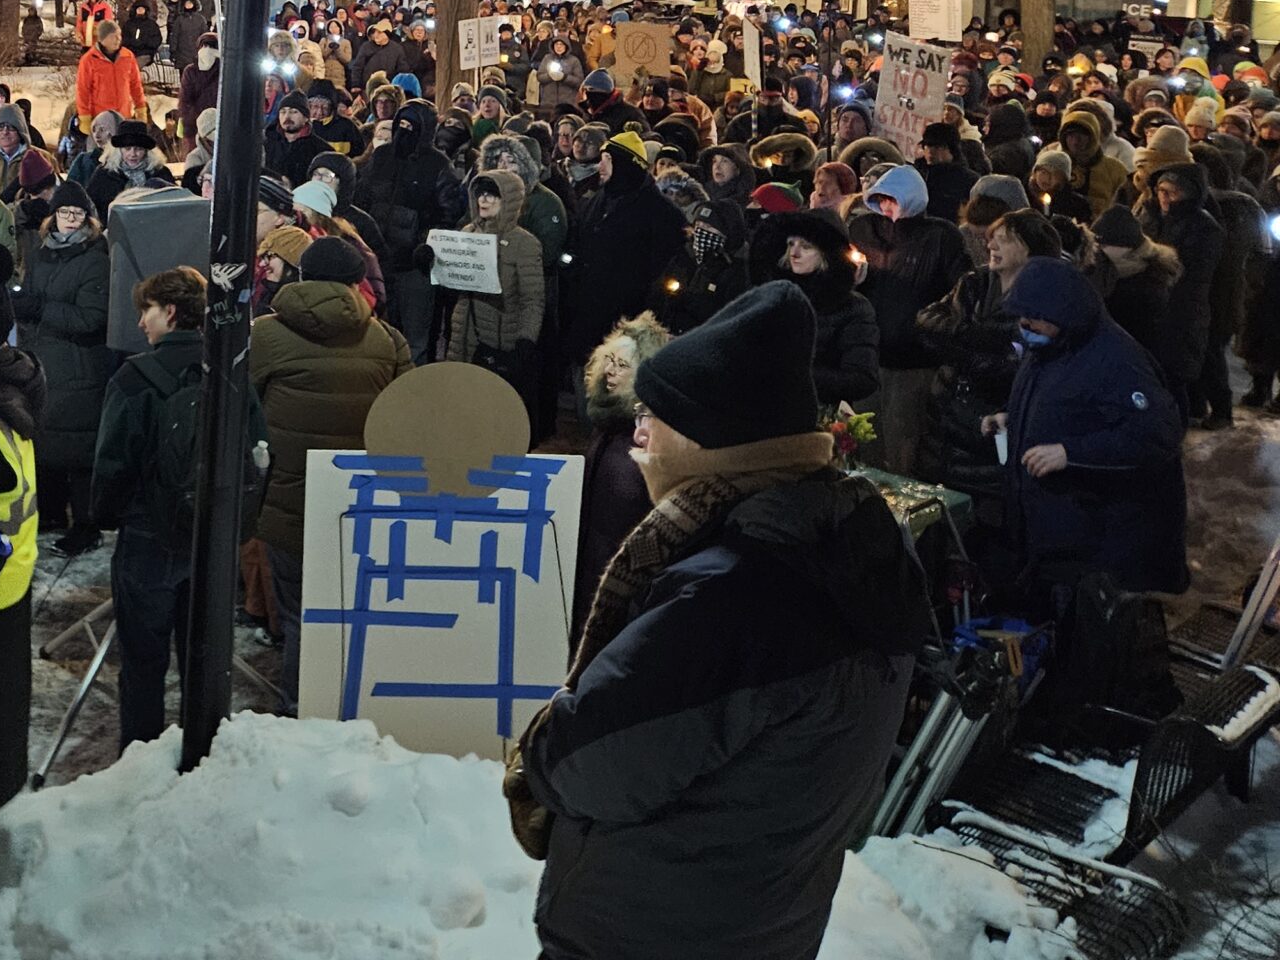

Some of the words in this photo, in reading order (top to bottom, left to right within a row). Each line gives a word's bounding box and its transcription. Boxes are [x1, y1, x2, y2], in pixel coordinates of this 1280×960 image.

[1122, 3, 1152, 18] ICE
[887, 43, 912, 65] WE
[915, 48, 946, 74] SAY
[893, 64, 929, 99] NO
